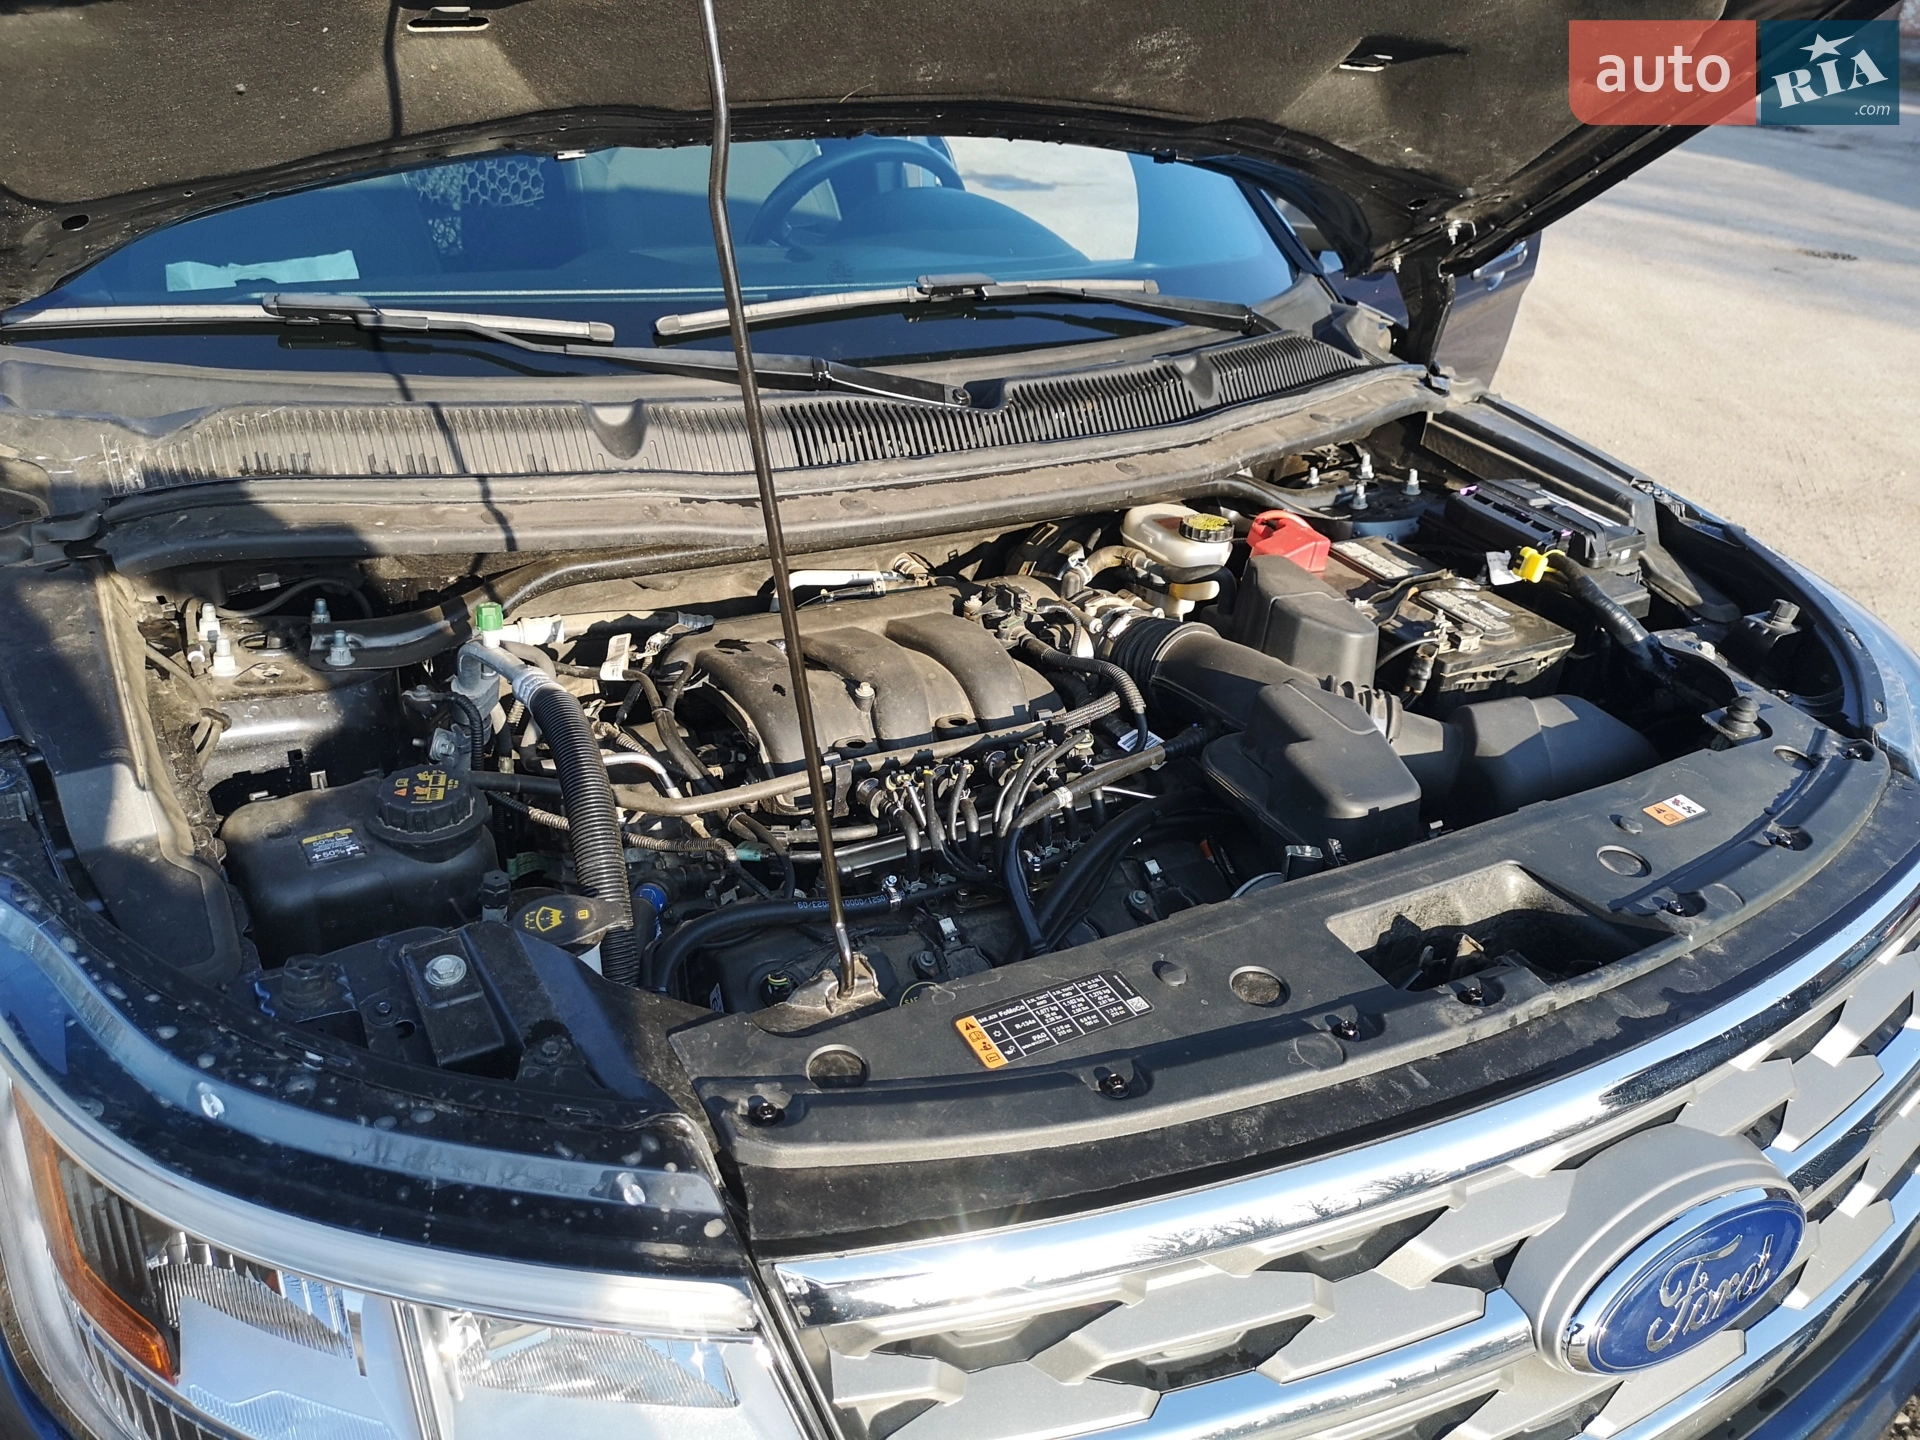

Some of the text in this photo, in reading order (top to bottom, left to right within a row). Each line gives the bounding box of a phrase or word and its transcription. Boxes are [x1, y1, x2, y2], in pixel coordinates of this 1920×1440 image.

[998, 1005, 1025, 1016] FoMoCo
[1015, 1020, 1036, 1029] R-134a
[1646, 1233, 1774, 1353] Ford
